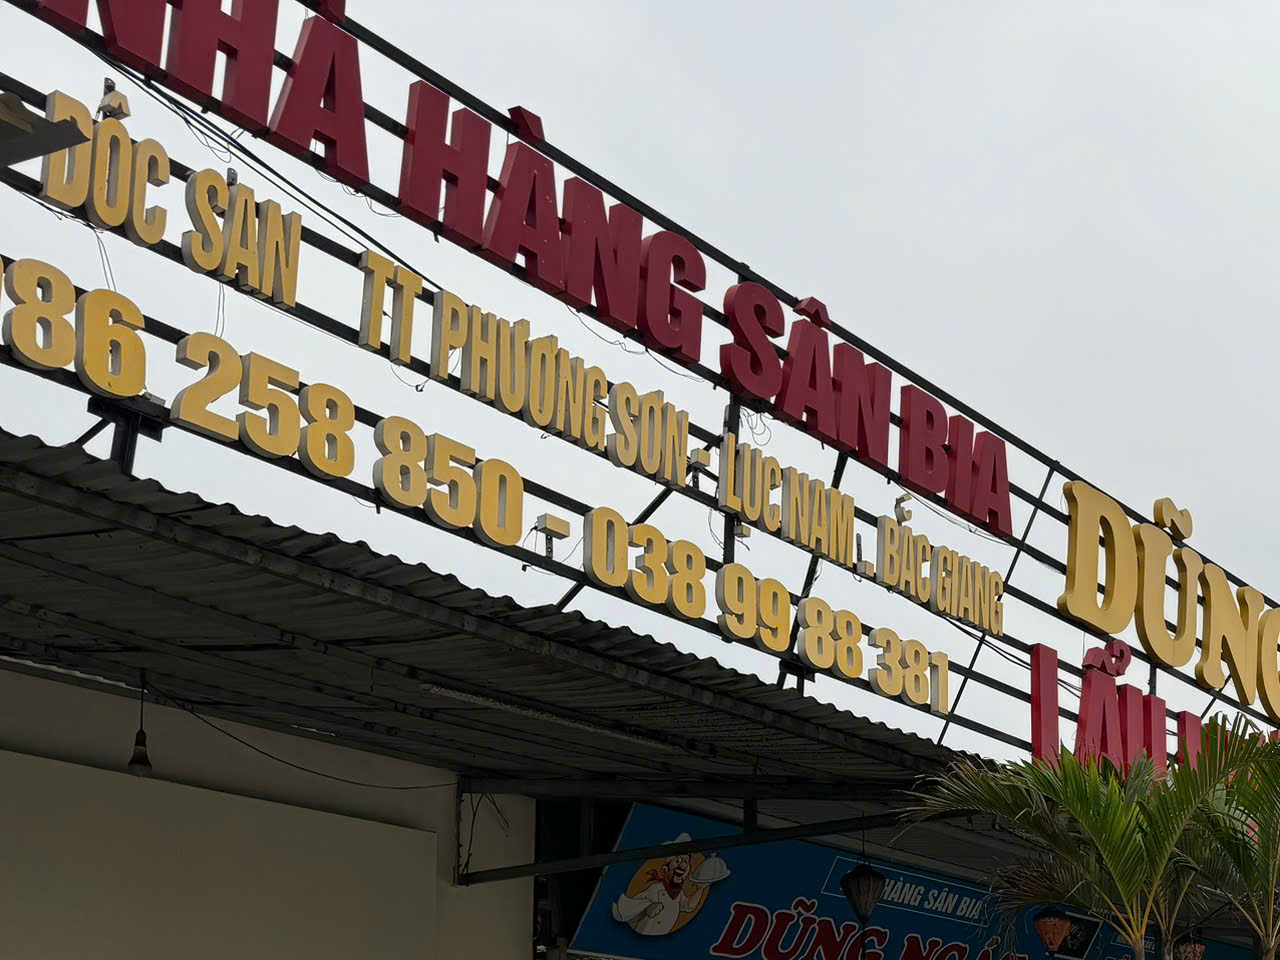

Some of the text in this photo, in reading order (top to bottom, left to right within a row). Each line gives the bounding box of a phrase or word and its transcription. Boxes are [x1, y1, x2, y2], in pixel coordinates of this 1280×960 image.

[20, 0, 1013, 537] HÀ HÀNG SÂN BIA
[358, 249, 423, 366] TT
[430, 288, 608, 452] PHƯƠNG
[607, 381, 690, 489] SƠN
[782, 466, 855, 568] NAM
[876, 494, 931, 604] BẮC
[930, 544, 1004, 638] GIANG
[170, 332, 356, 480] 258
[373, 415, 524, 547] 850
[584, 506, 706, 620] 038
[715, 562, 792, 652] 99
[798, 597, 863, 679] 88
[868, 627, 950, 715] 381
[881, 875, 925, 906] HÀNG
[923, 885, 957, 915] SÂN
